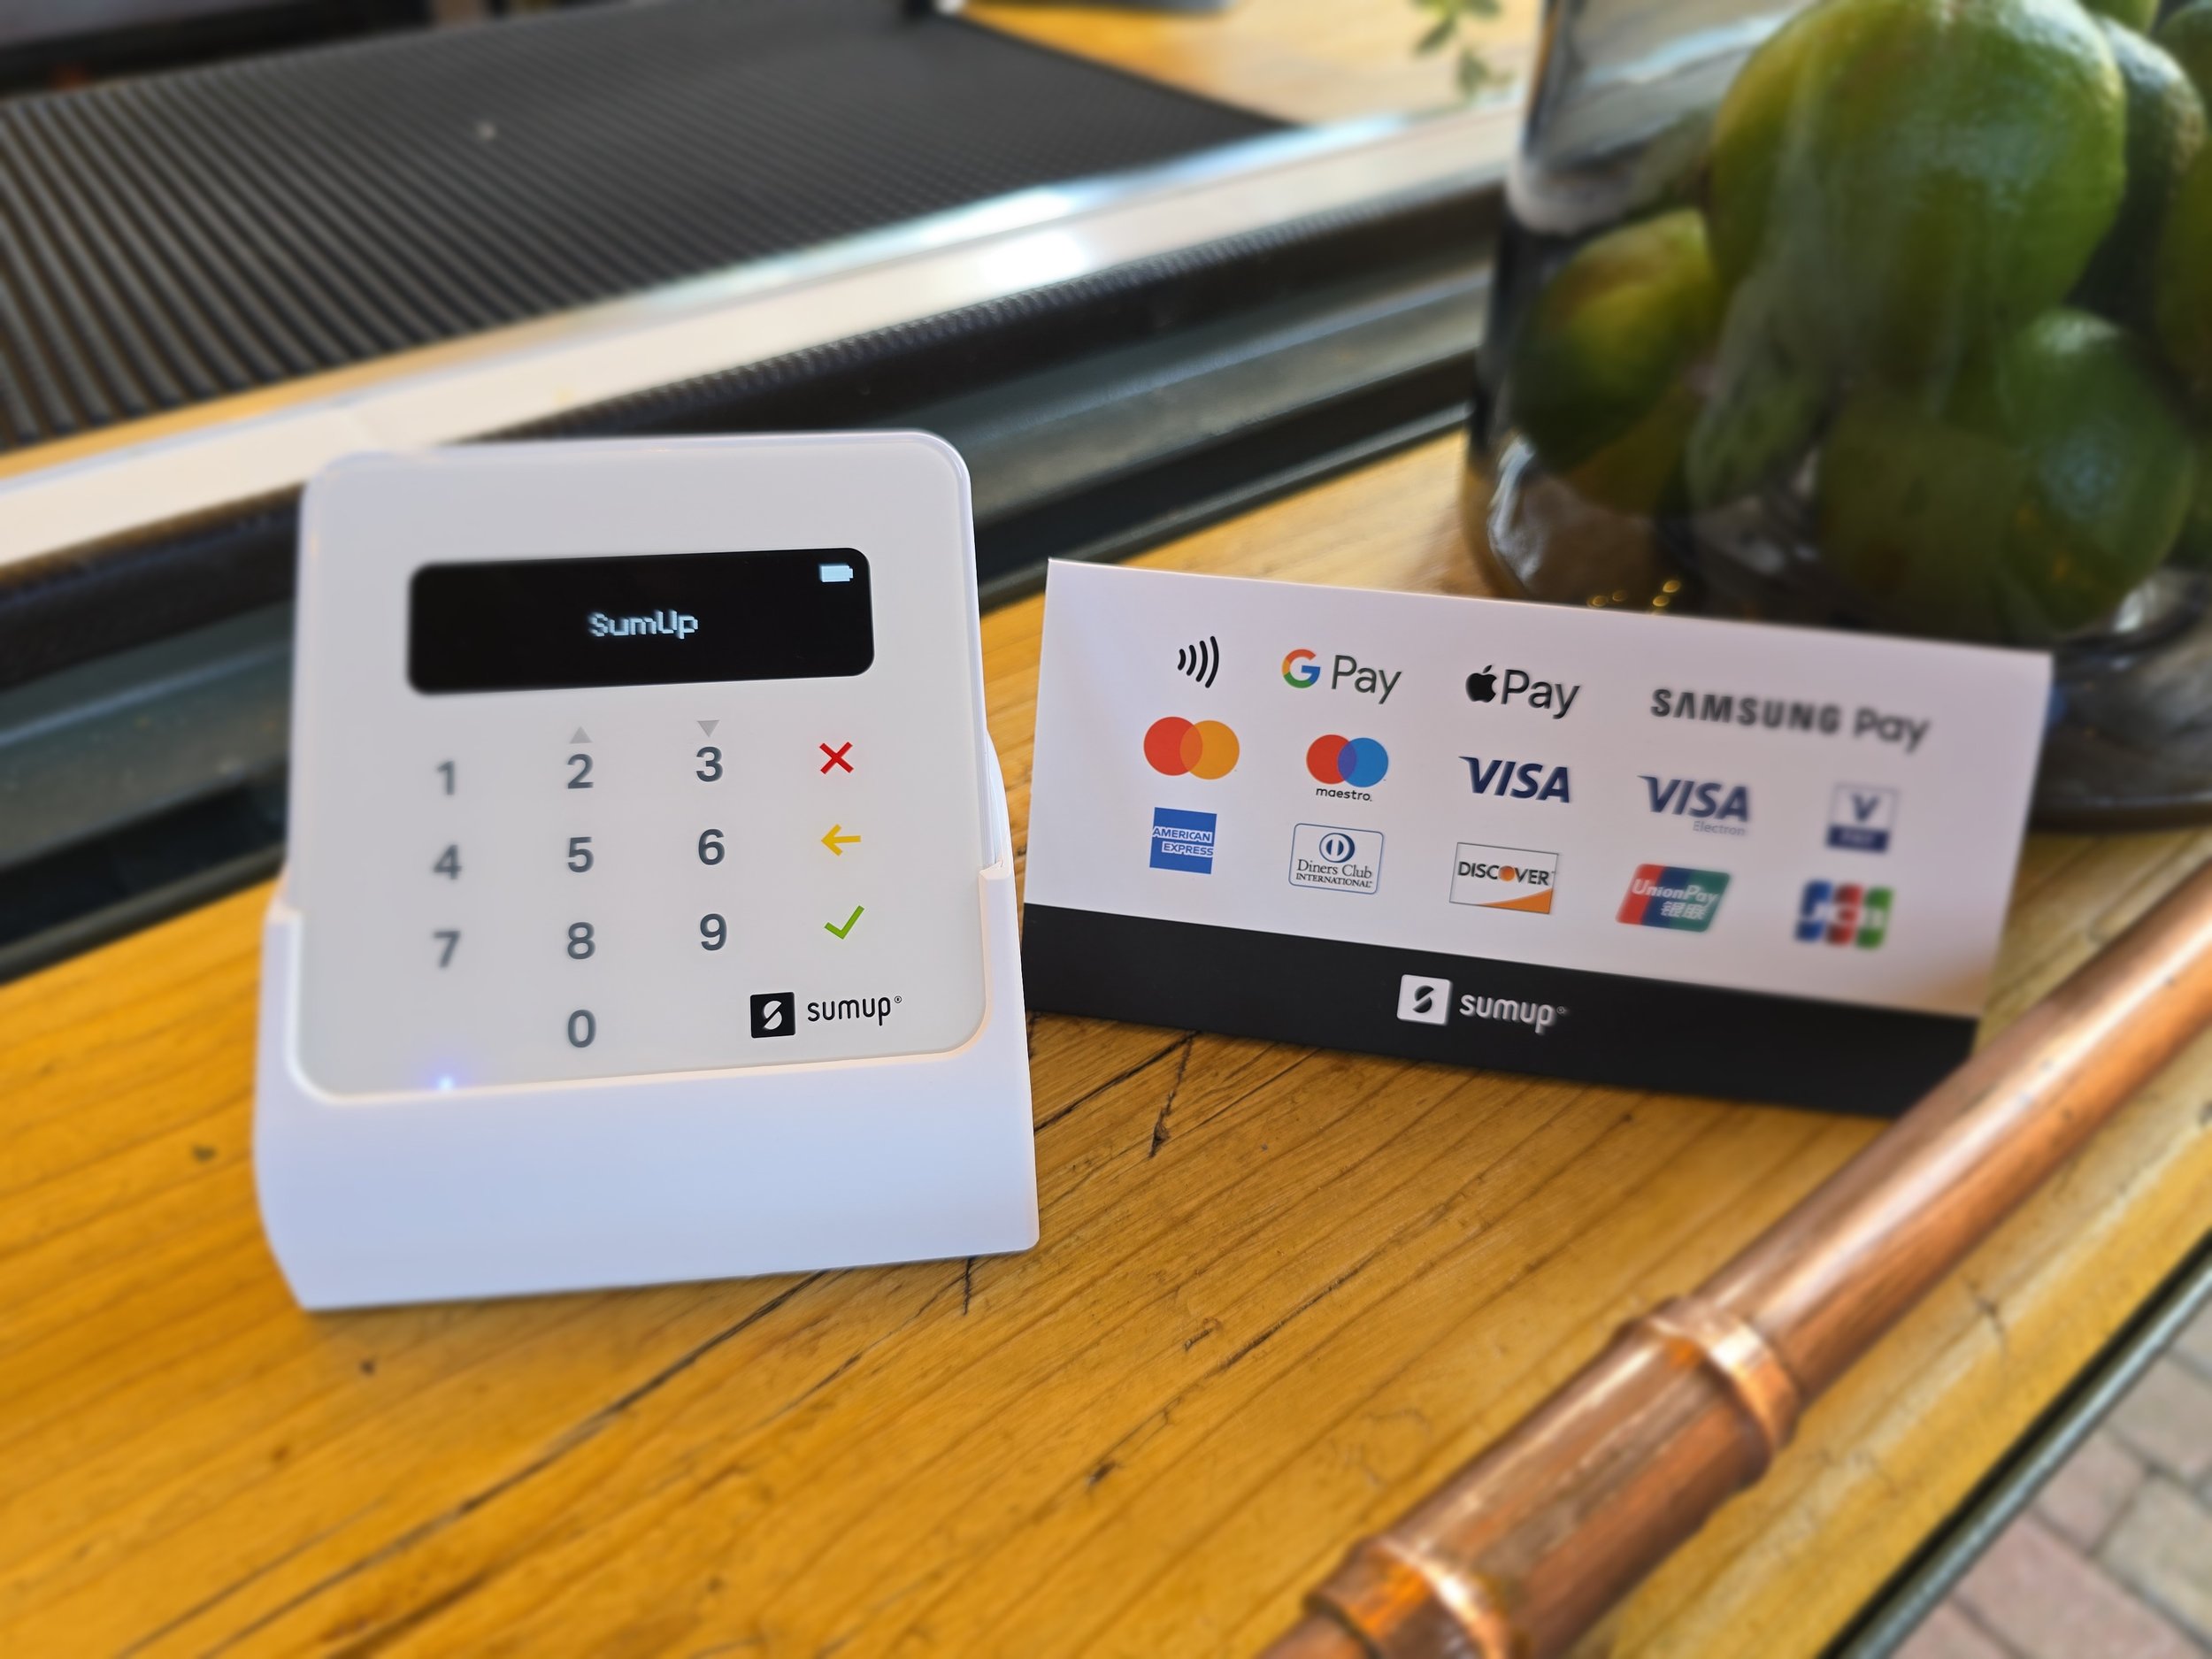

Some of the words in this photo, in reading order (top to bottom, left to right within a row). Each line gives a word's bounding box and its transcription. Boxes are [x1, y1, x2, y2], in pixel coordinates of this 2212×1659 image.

[588, 610, 699, 639] SumUp
[1331, 654, 1402, 704] Pay
[1501, 669, 1581, 719] Pay
[1650, 687, 1841, 735] SAMSUNG
[1853, 707, 1931, 754] Pay
[436, 759, 457, 795] 1
[566, 753, 594, 789] 2
[695, 746, 724, 782] 3
[1459, 756, 1572, 803] VISA
[1637, 775, 1750, 822] VISA
[1152, 827, 1210, 841] AMERICAN
[1693, 820, 1746, 837] Electron
[433, 843, 462, 880] 4
[566, 836, 595, 873] 5
[697, 828, 726, 865] 6
[1163, 842, 1213, 856] EXPRESS
[1295, 872, 1371, 888] INTERNATIONAL
[1296, 859, 1338, 875] Diners
[1341, 864, 1372, 879] Club
[1457, 861, 1549, 886] DISCOVER
[1632, 879, 1718, 907] UnionPay
[433, 930, 462, 969] 7
[566, 921, 596, 960] 8
[699, 913, 727, 951] 9
[567, 1009, 596, 1048] 0
